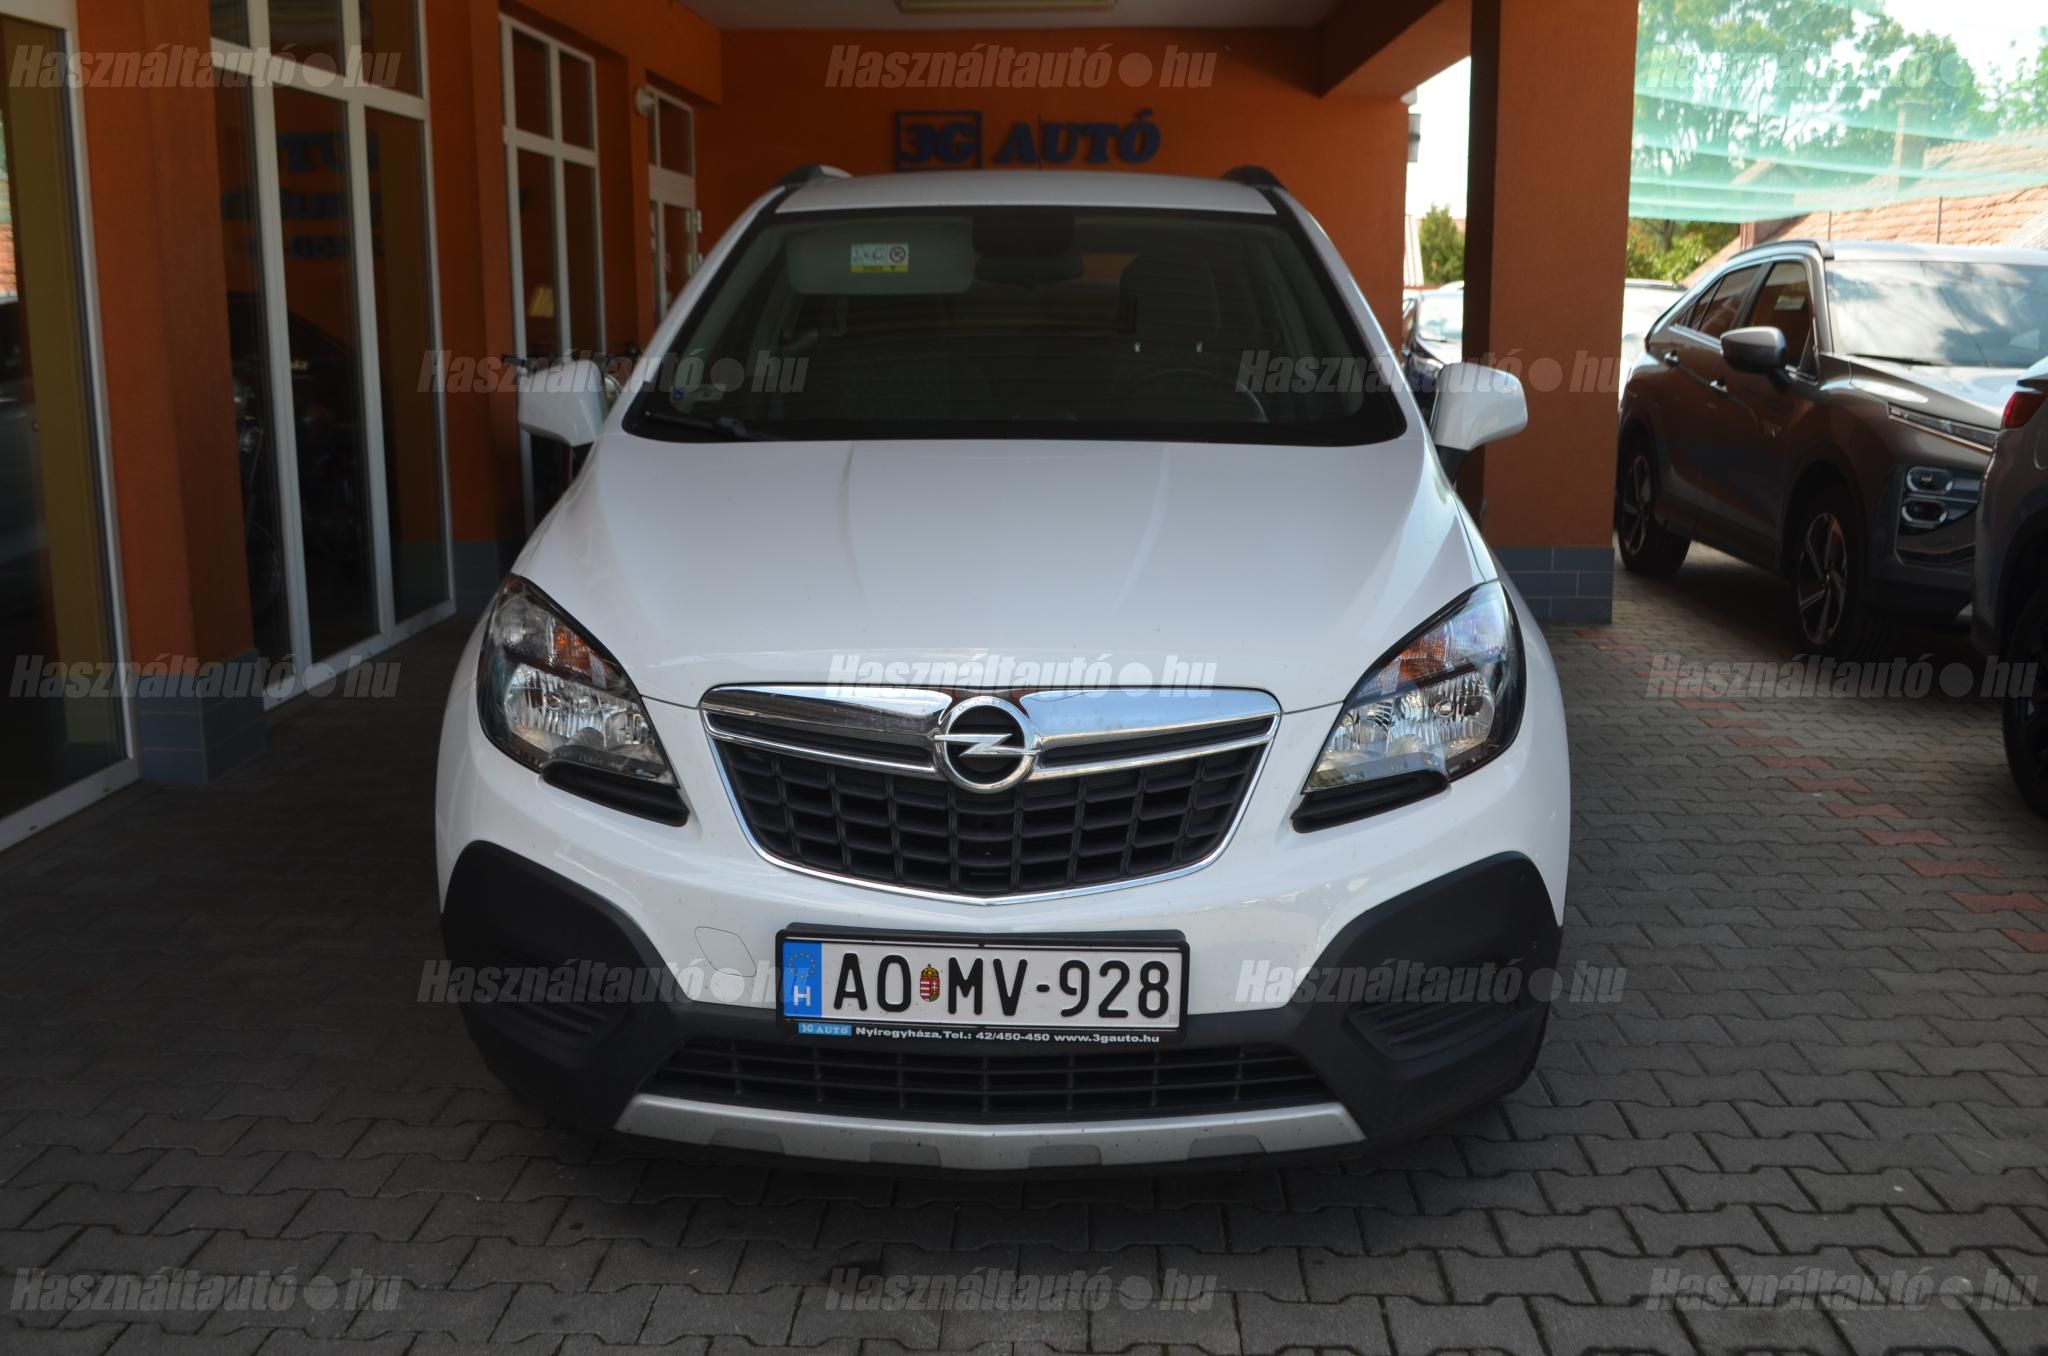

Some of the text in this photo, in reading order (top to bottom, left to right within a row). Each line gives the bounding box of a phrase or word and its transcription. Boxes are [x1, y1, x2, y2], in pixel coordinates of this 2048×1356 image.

[996, 109, 1161, 164] AUTÓ
[793, 986, 811, 1007] H
[835, 953, 1169, 1018] AO MV-928
[976, 1032, 1050, 1041] 42/450-450
[1054, 1034, 1160, 1044] www.3gauto.hu
